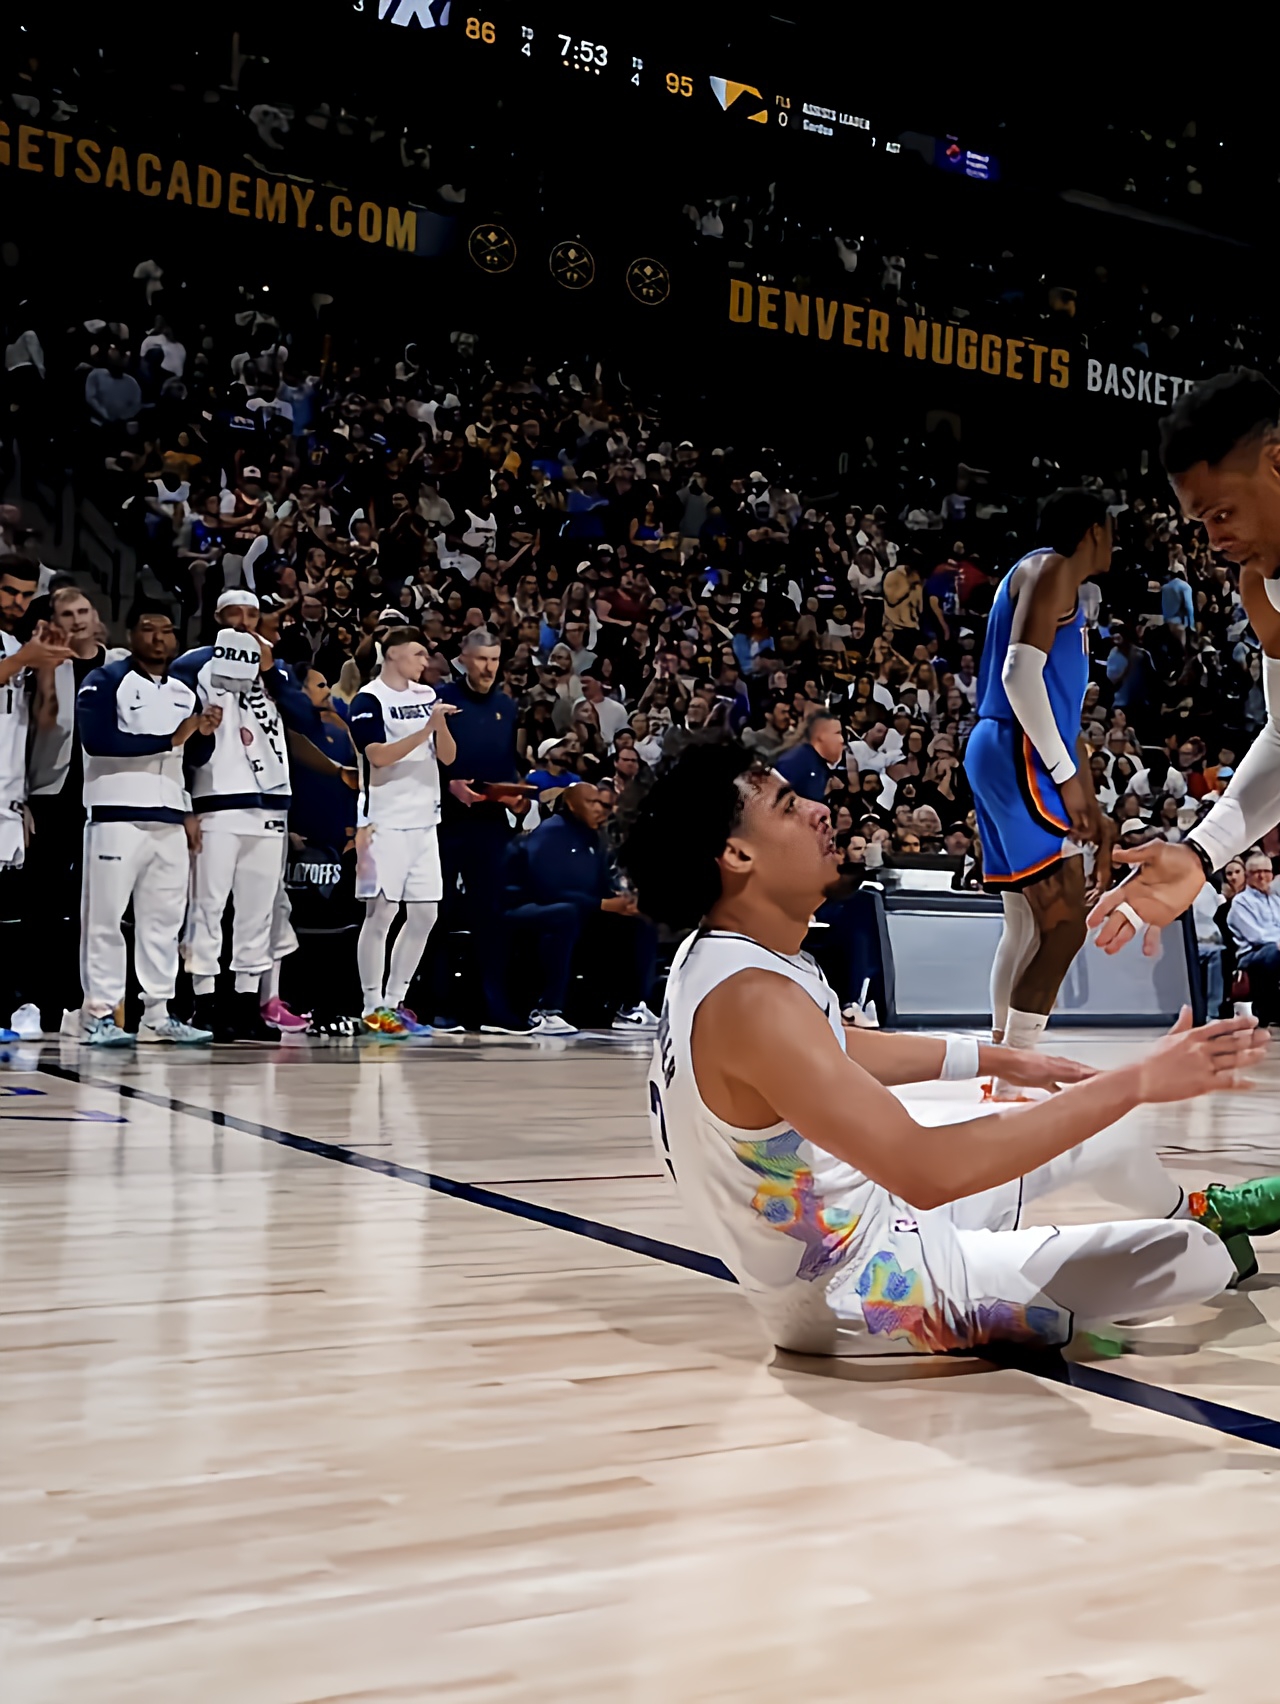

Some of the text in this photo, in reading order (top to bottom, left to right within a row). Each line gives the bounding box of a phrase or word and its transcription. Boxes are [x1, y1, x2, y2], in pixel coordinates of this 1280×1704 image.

[466, 17, 496, 44] 86
[521, 43, 531, 57] 4
[558, 33, 608, 67] 7:53
[631, 73, 640, 87] 4
[666, 72, 694, 97] 95
[728, 278, 890, 353] DENVER
[903, 315, 1070, 389] NUGGETS
